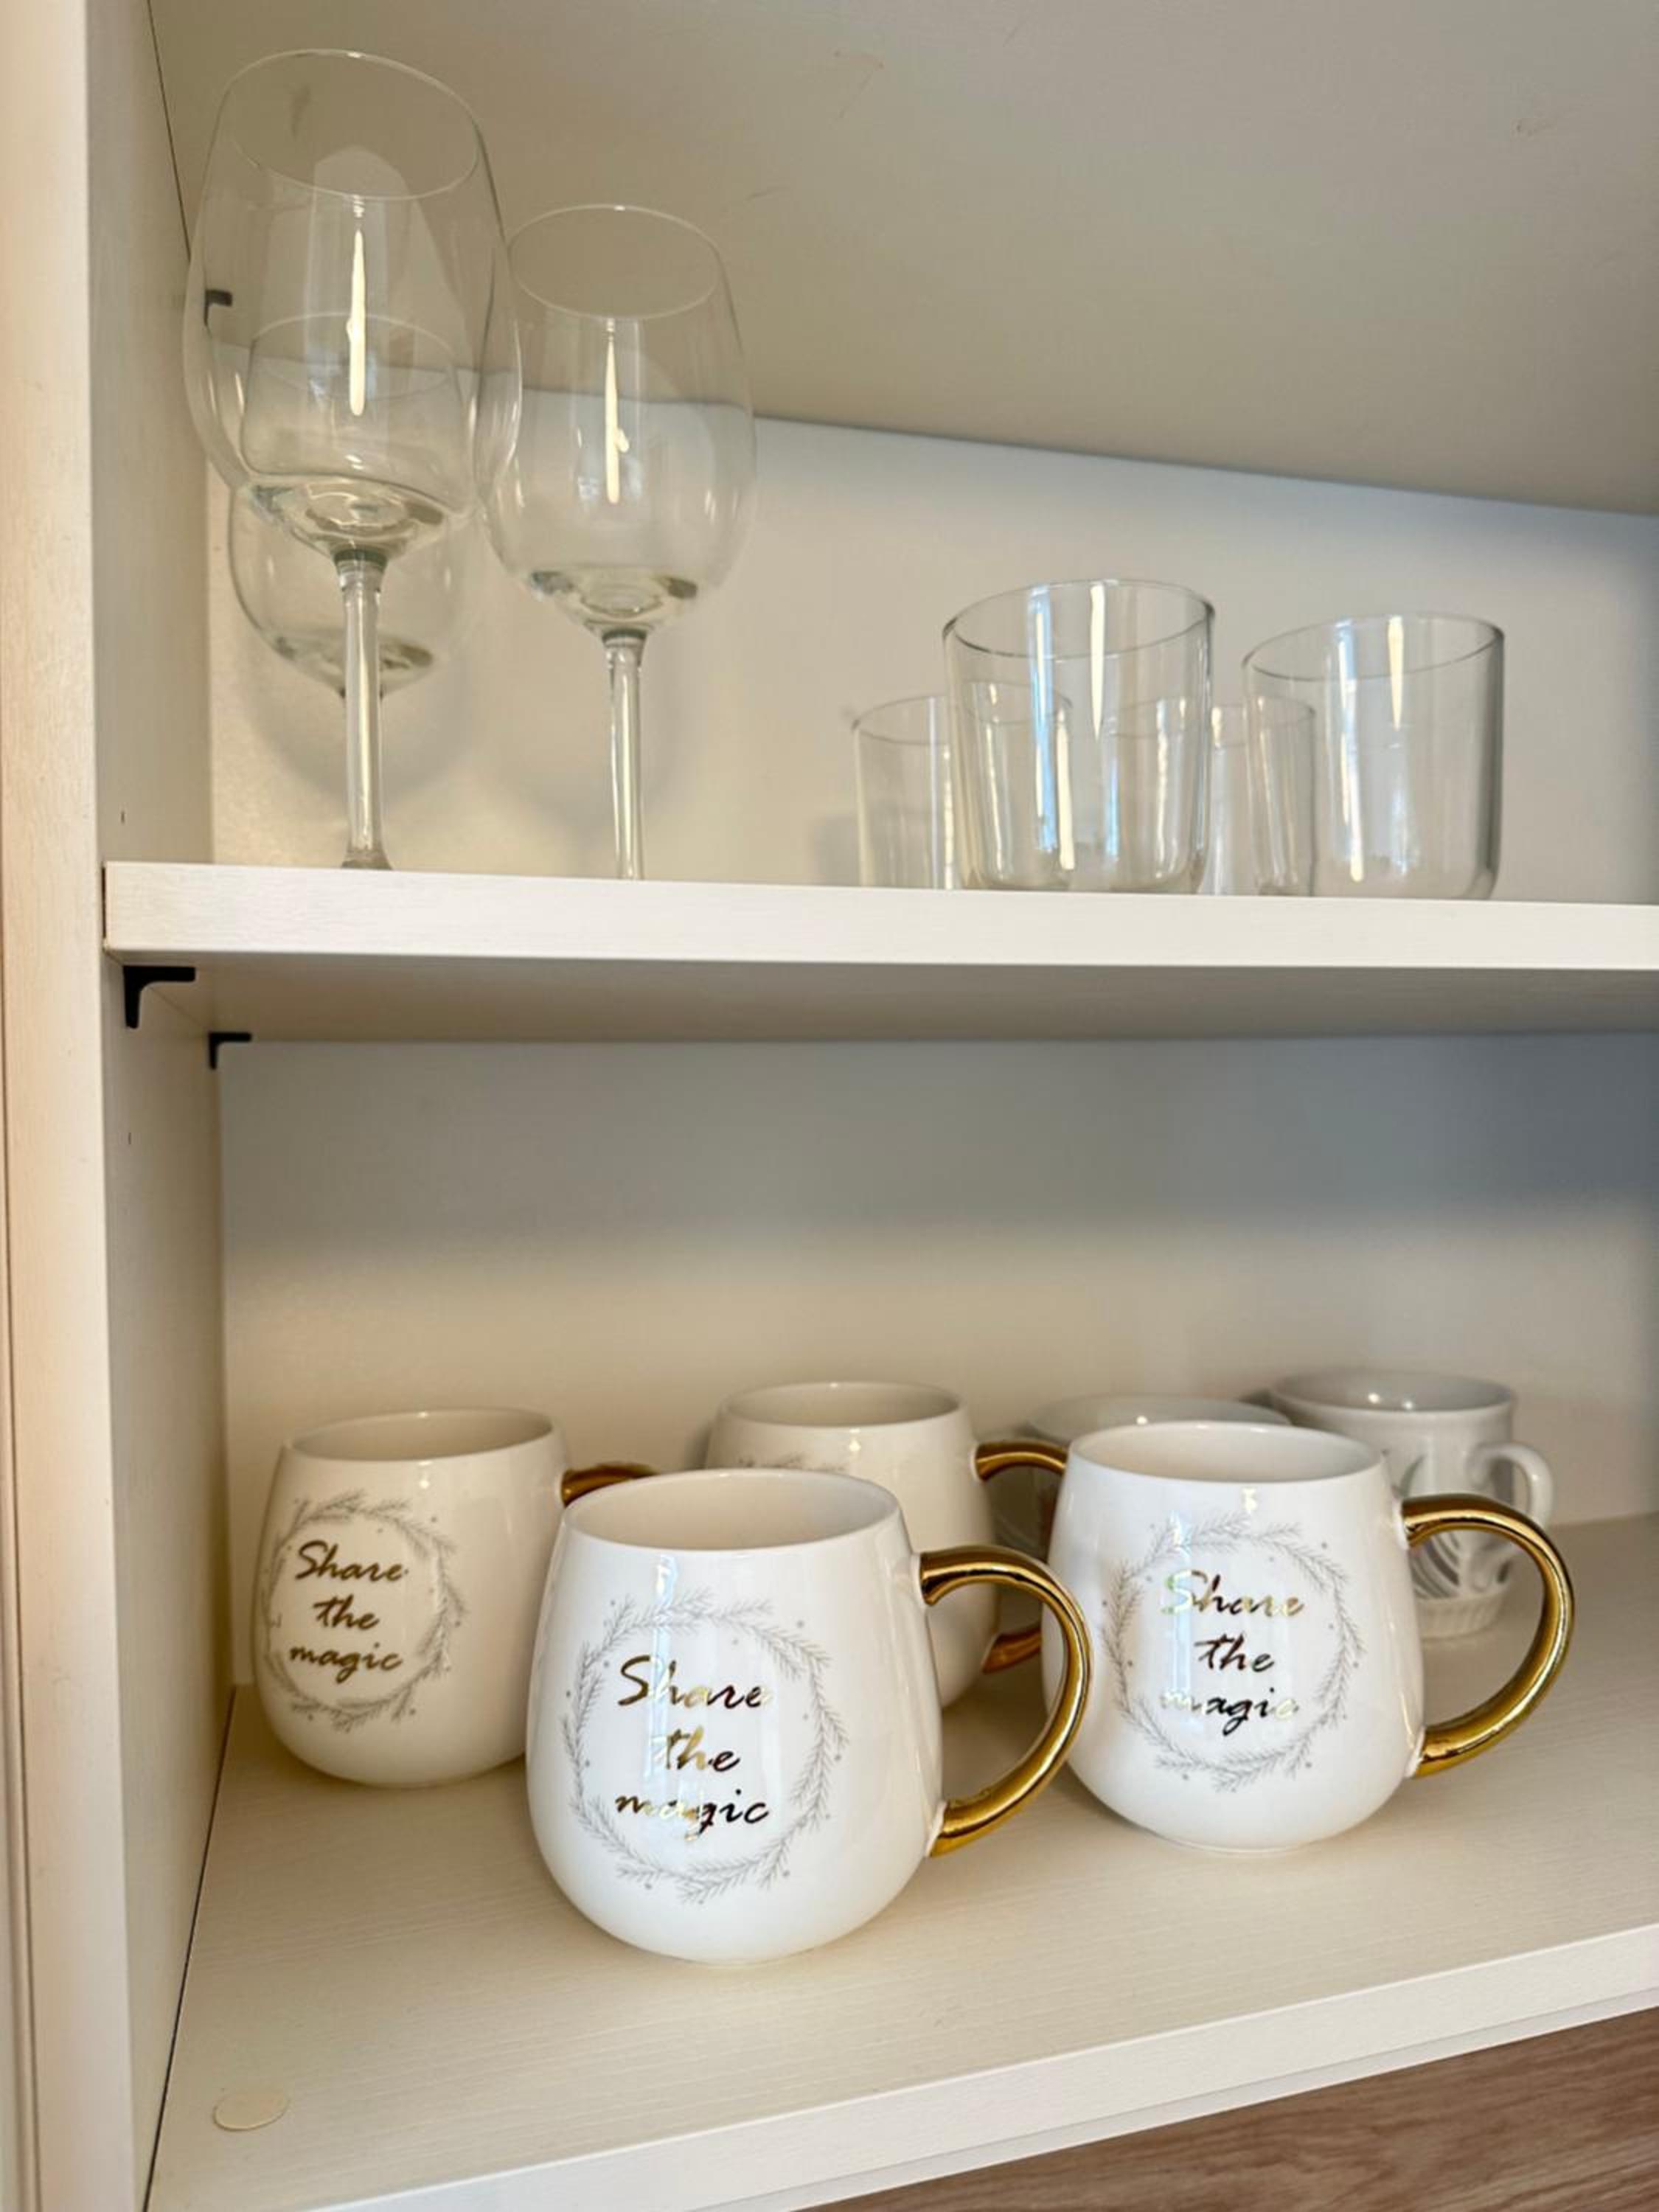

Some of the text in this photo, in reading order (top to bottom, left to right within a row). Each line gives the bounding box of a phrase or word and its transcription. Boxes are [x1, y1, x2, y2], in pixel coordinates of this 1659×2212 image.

[294, 1539, 409, 1582] Share
[313, 1593, 380, 1630] the
[1161, 1569, 1305, 1617] Share
[289, 1643, 403, 1685] magic
[1194, 1632, 1276, 1673] the
[617, 1655, 772, 1709] Share
[651, 1725, 741, 1773] the
[615, 1789, 770, 1842] magic
